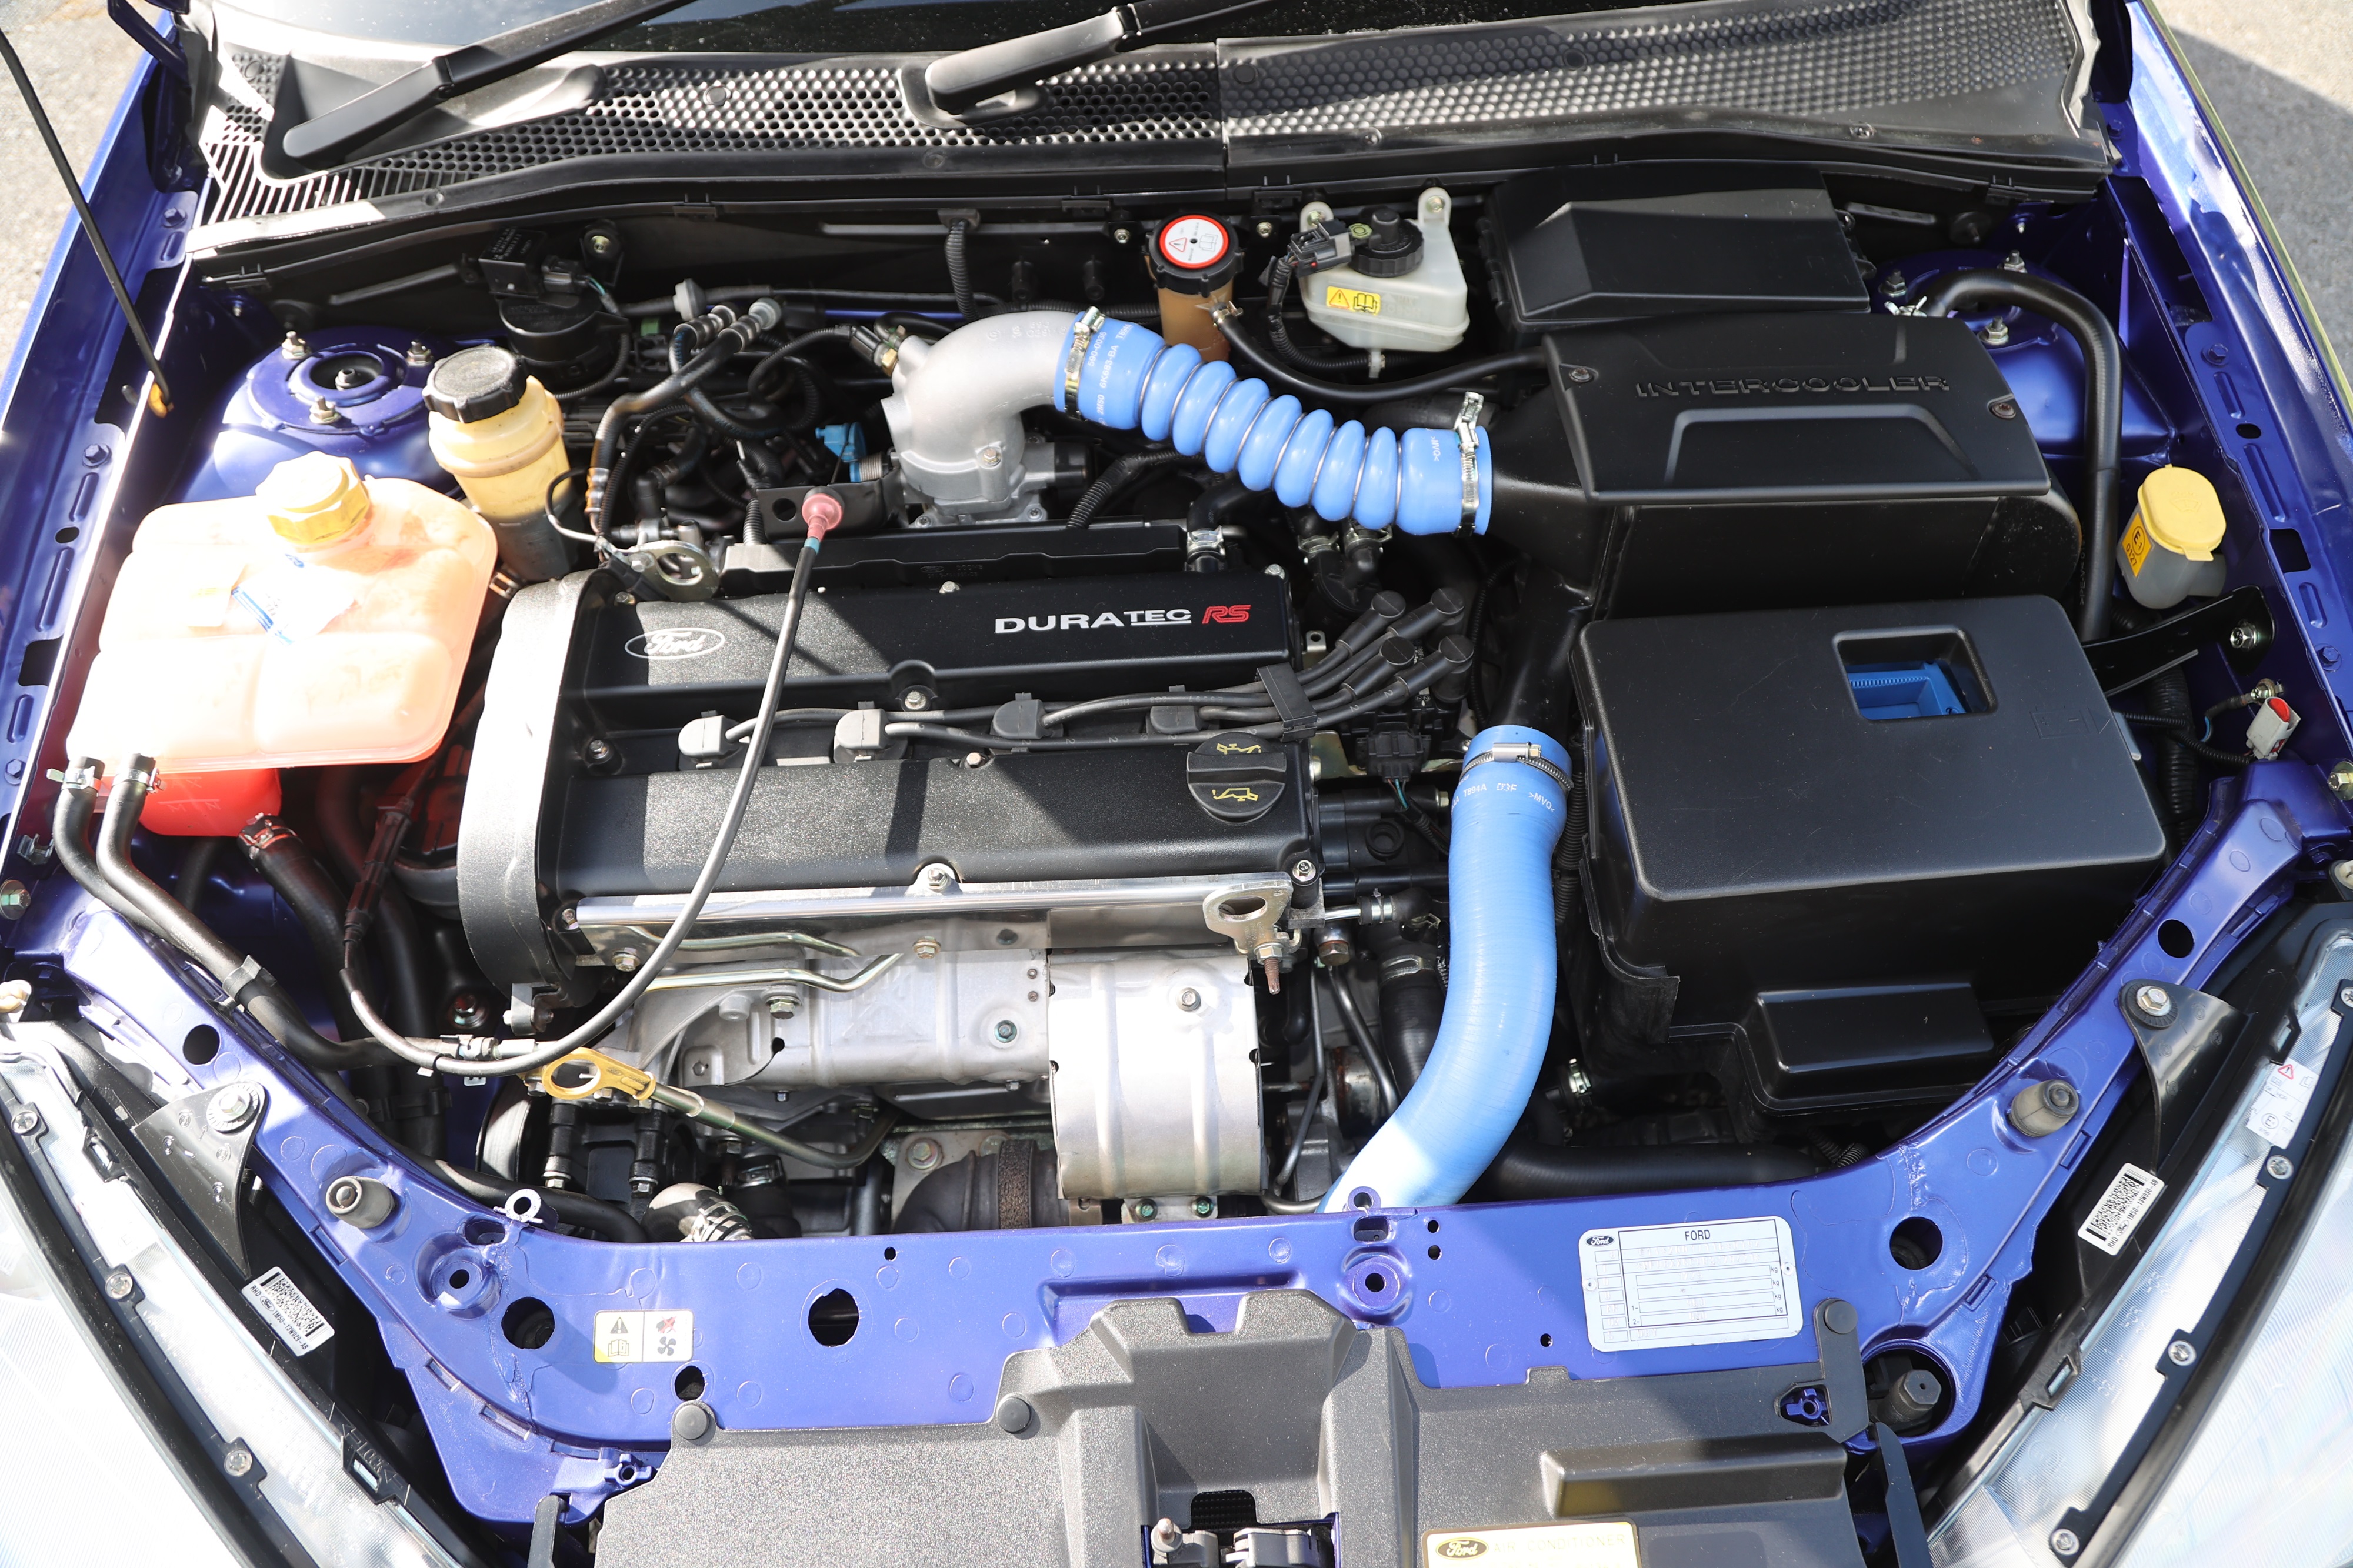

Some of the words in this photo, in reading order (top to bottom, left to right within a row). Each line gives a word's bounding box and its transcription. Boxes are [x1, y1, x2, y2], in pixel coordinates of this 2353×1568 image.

[1088, 332, 1107, 366] 590-0036
[1635, 375, 1951, 398] INTERCOOLER
[2126, 543, 2137, 566] 0127
[995, 608, 1191, 634] DURATEC
[1201, 605, 1251, 624] RS
[634, 630, 715, 657] Ford
[1384, 689, 1394, 698] 2
[1463, 783, 1487, 797] T894A
[2107, 1236, 2118, 1248] RHD
[2127, 1179, 2158, 1220] 1M50-13W030-AB
[1588, 1236, 1612, 1246] Ford
[1684, 1229, 1711, 1242] FORD
[1772, 1279, 1780, 1287] kg
[250, 1285, 262, 1297] RHD
[272, 1310, 309, 1350] 1M50-13W029-AB
[1776, 1305, 1784, 1313] kg
[1442, 1539, 1482, 1557] Ford
[1494, 1542, 1516, 1553] AIR
[1527, 1533, 1626, 1552] CONDITIONER
